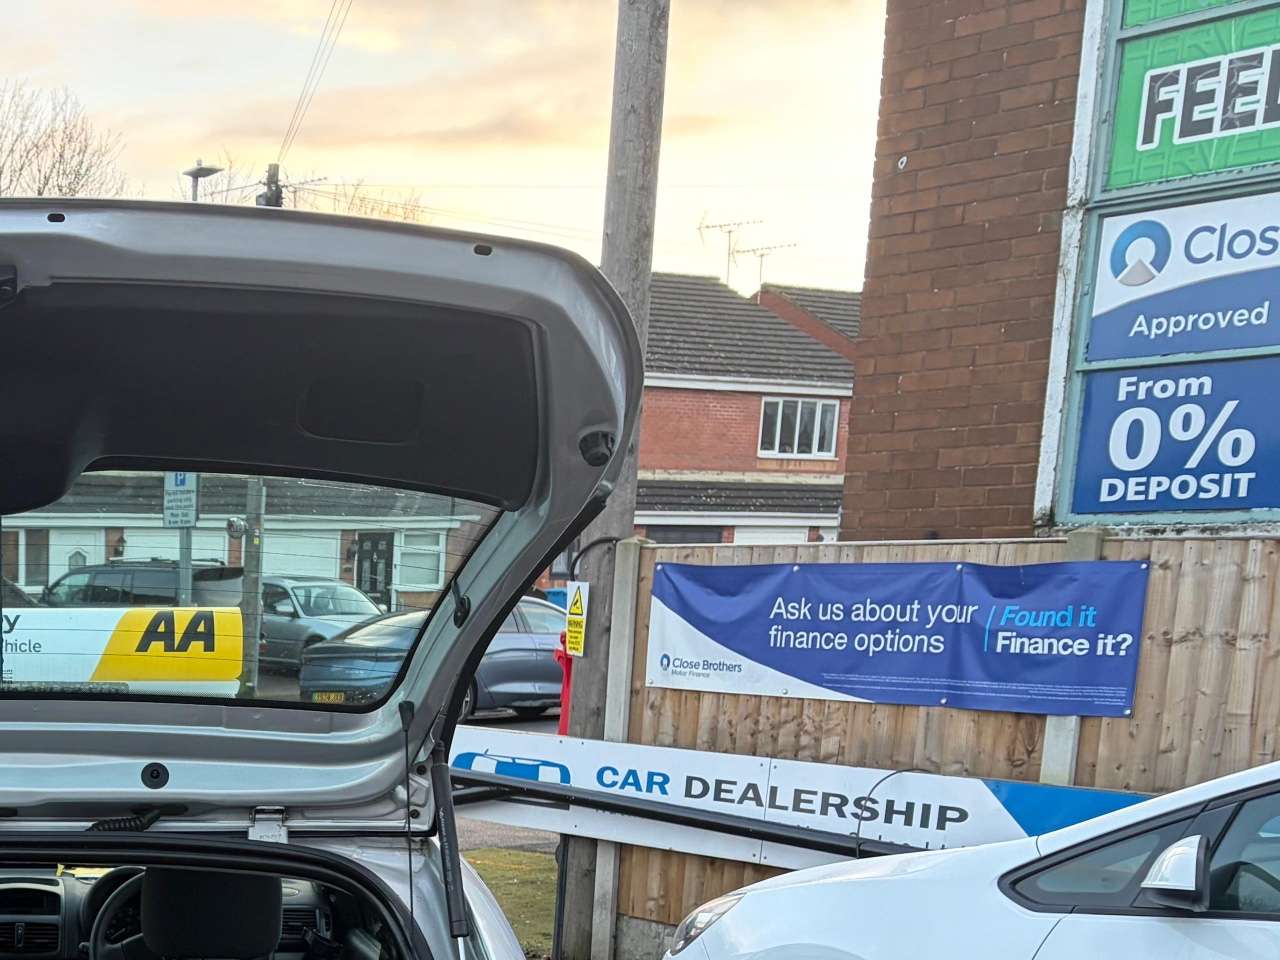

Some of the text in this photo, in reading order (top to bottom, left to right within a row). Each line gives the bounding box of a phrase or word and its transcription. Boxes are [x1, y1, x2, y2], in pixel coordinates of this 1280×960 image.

[1137, 47, 1280, 150] FEE
[1128, 300, 1270, 339] Approved
[1117, 376, 1213, 401] From
[1108, 399, 1256, 472] 0%
[1099, 472, 1257, 503] DEPOSIT
[769, 597, 979, 629] Ask us about your
[999, 605, 1097, 627] Found it
[135, 610, 216, 653] AA
[768, 625, 945, 657] finance options
[996, 631, 1133, 656] Finance it?
[672, 657, 743, 673] Close Brothers
[596, 766, 969, 832] CAR DEALERSHIP
